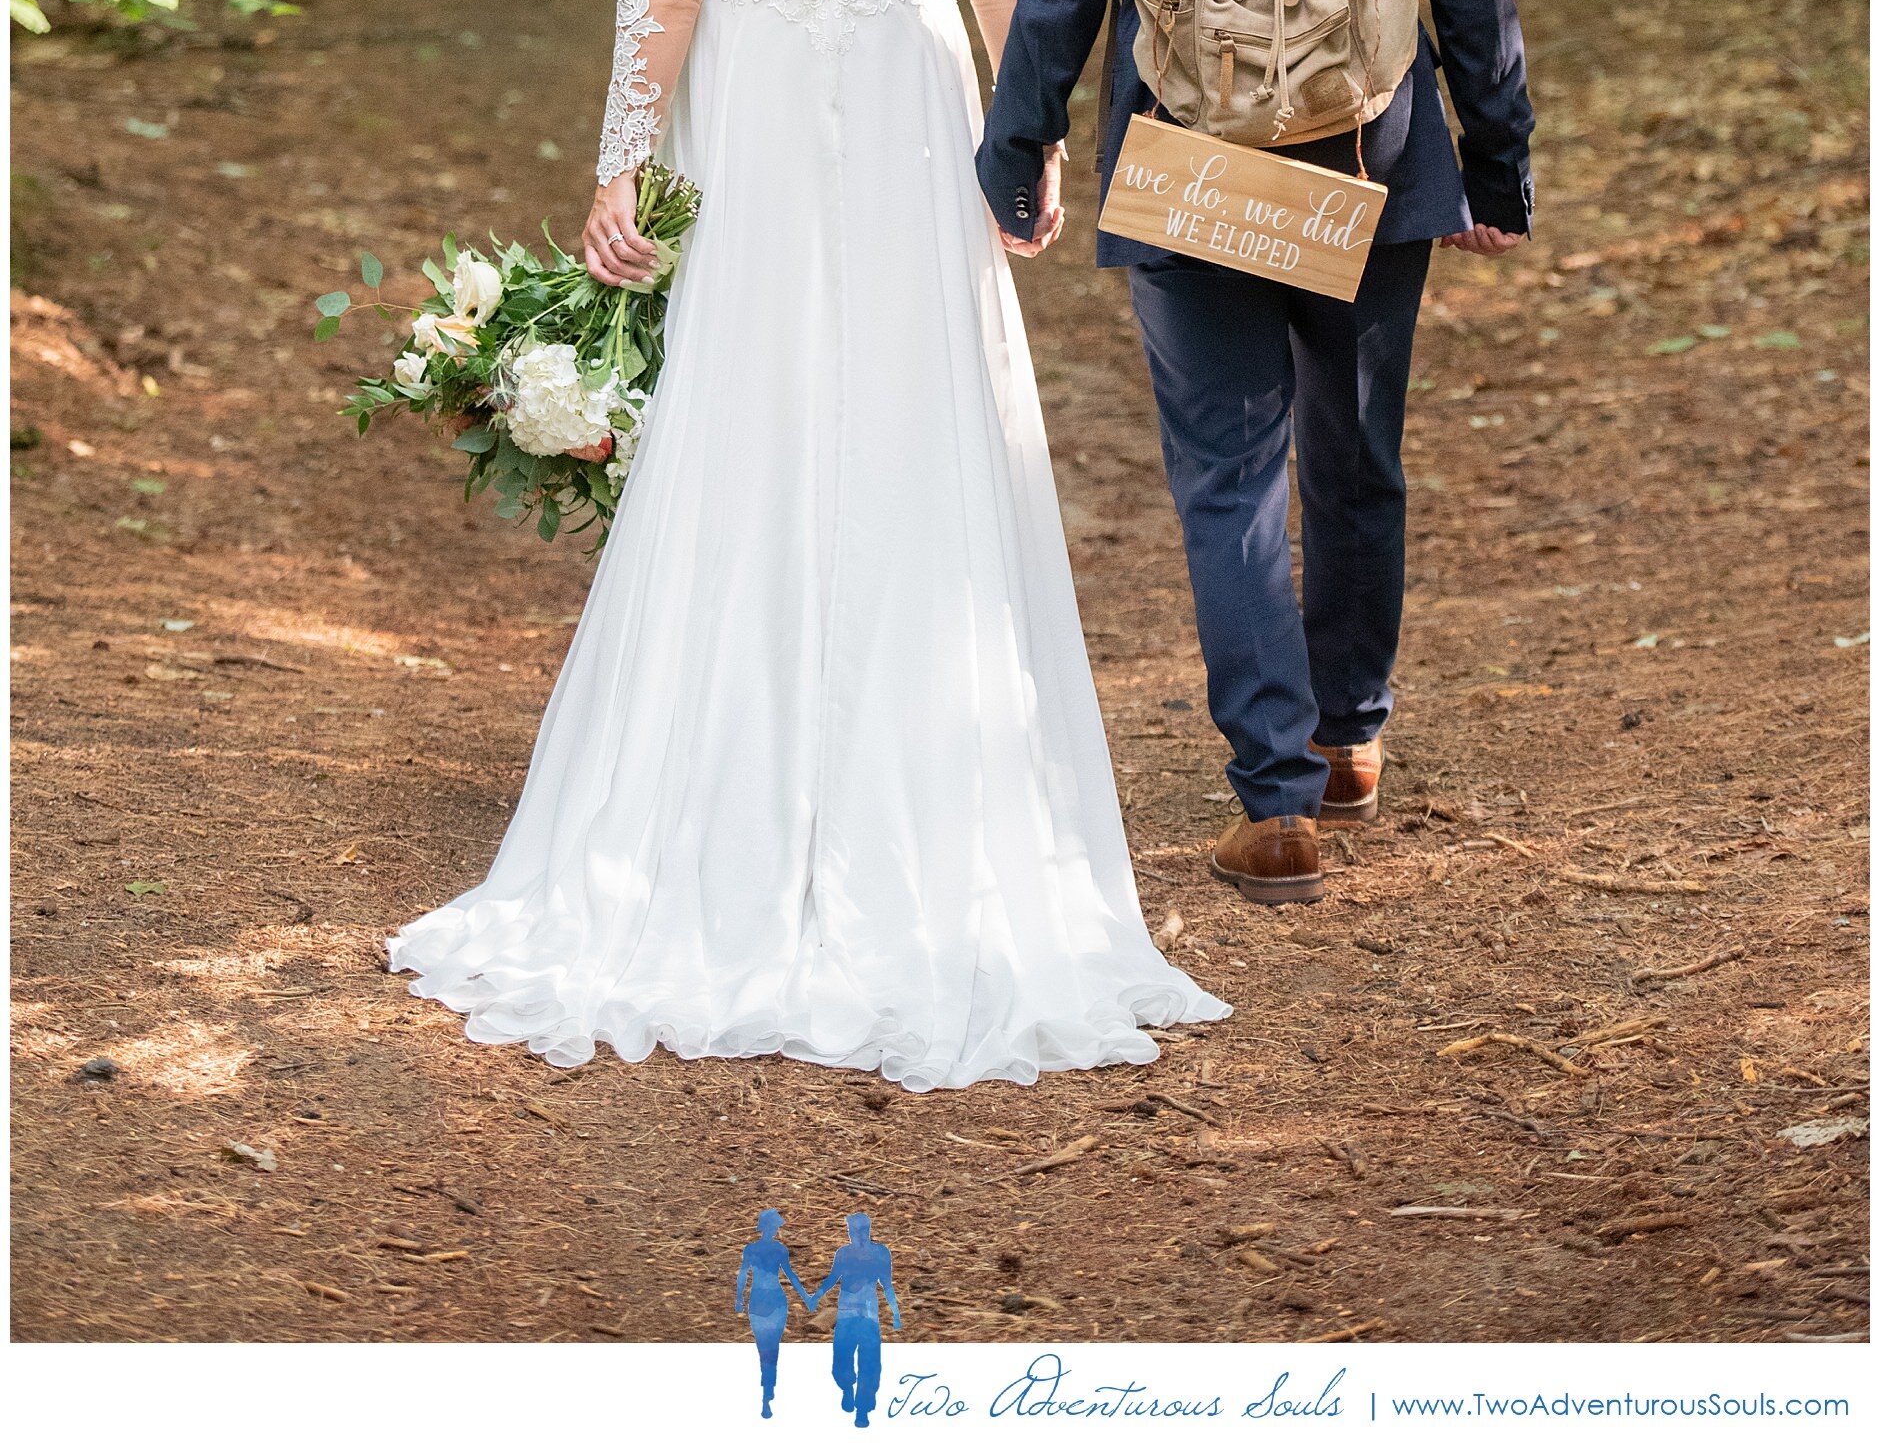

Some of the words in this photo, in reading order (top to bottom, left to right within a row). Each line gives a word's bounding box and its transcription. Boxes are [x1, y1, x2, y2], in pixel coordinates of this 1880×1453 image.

[1114, 163, 1175, 195] we
[1183, 155, 1228, 216] do,
[1245, 199, 1294, 230] we
[1302, 190, 1373, 250] did
[1165, 207, 1205, 244] WE
[1208, 220, 1300, 271] ELOPED
